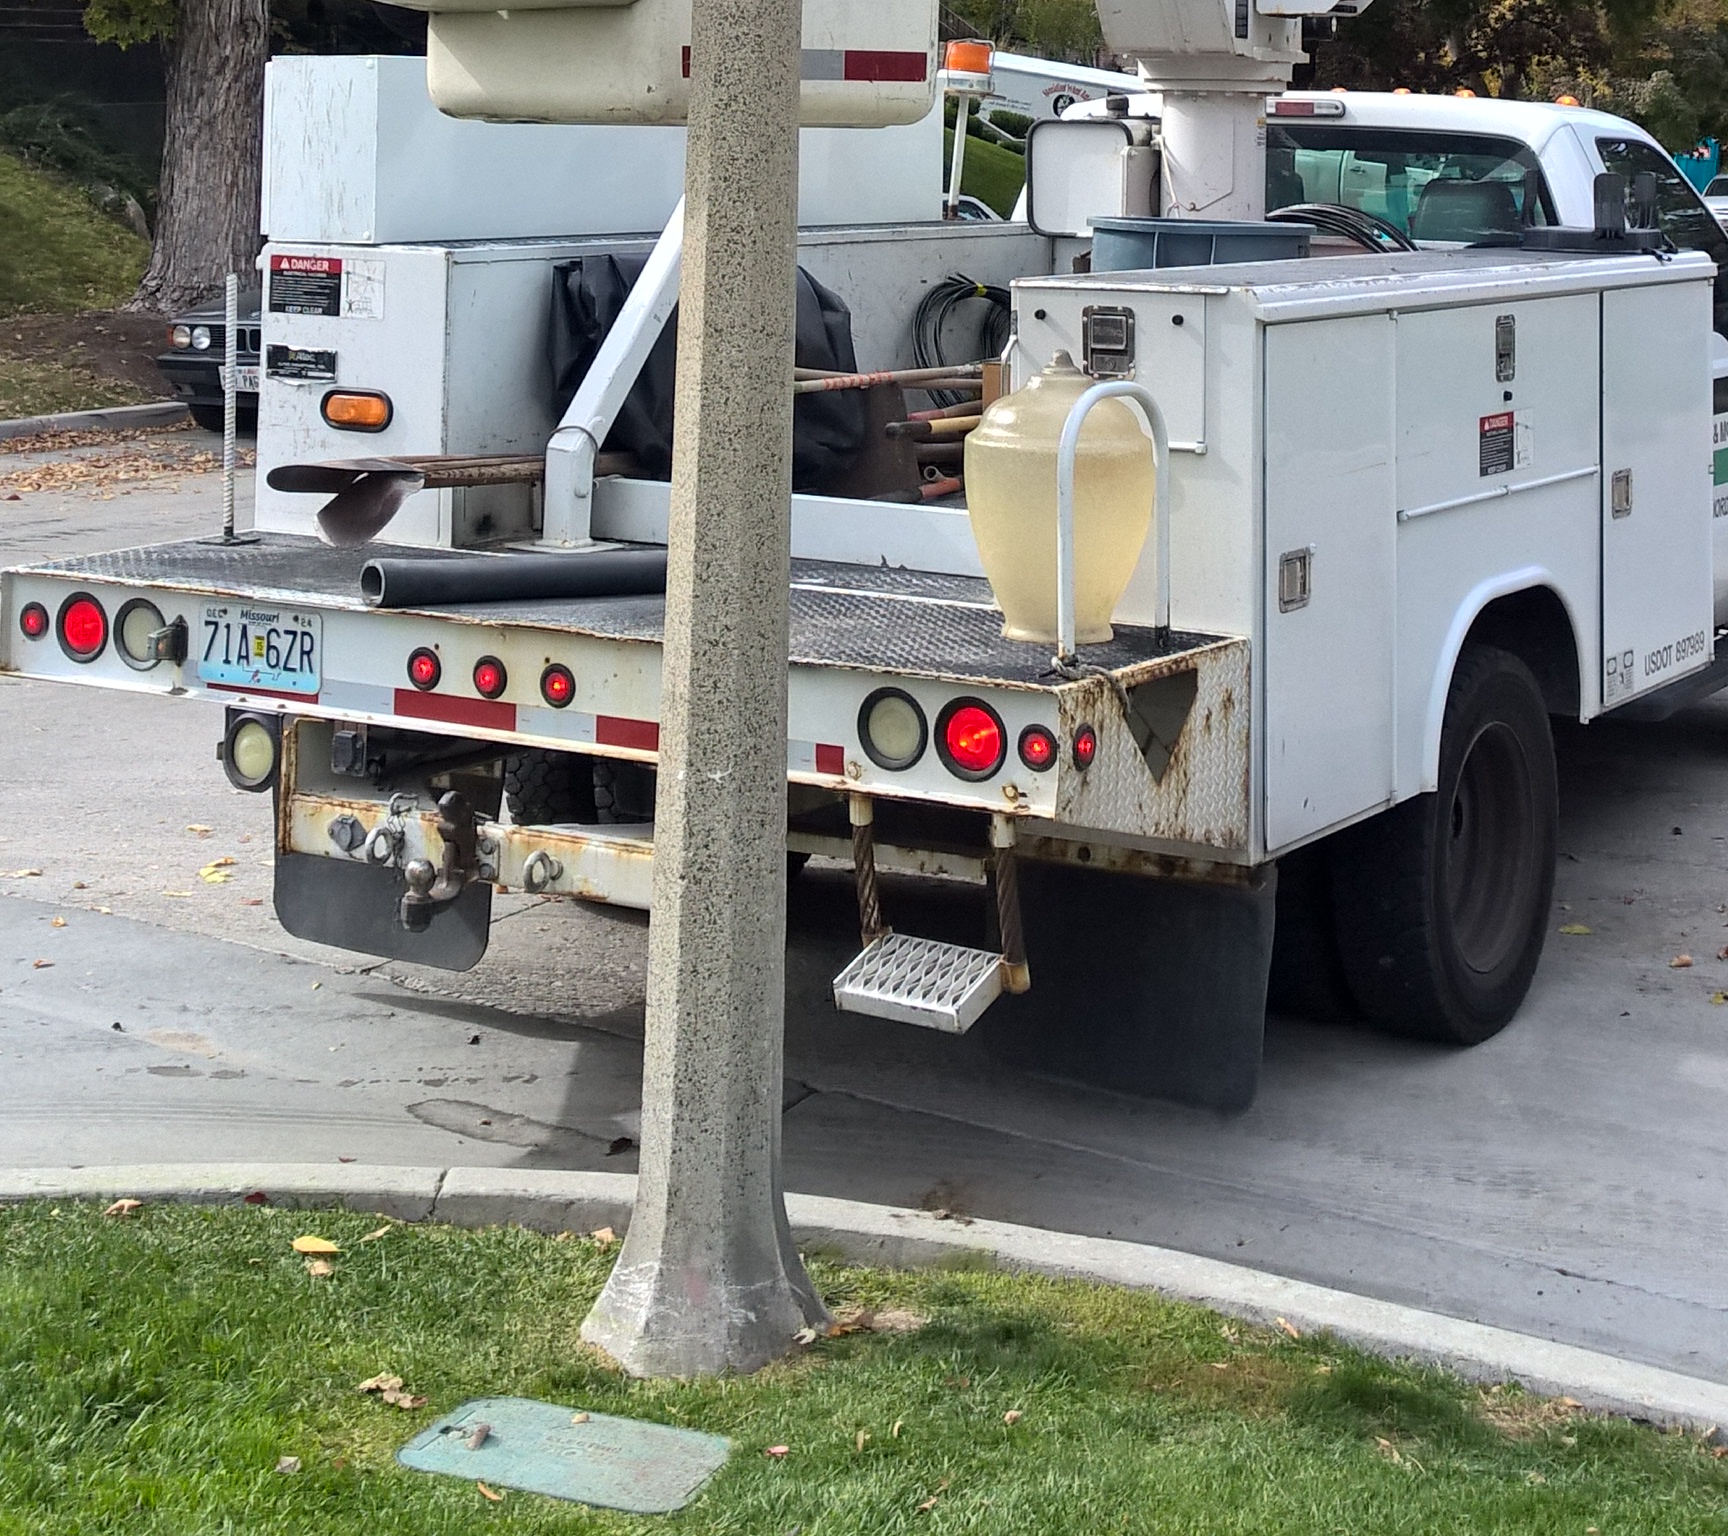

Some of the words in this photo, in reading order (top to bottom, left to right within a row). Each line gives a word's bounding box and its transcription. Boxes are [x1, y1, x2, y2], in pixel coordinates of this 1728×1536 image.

[290, 258, 329, 271] DANGER
[302, 306, 323, 314] CLEAR
[240, 609, 280, 624] Missouri
[203, 620, 251, 666] 71A
[266, 628, 315, 674] 6ZR
[1644, 644, 1674, 677] USDOT
[1675, 630, 1705, 663] 897989
